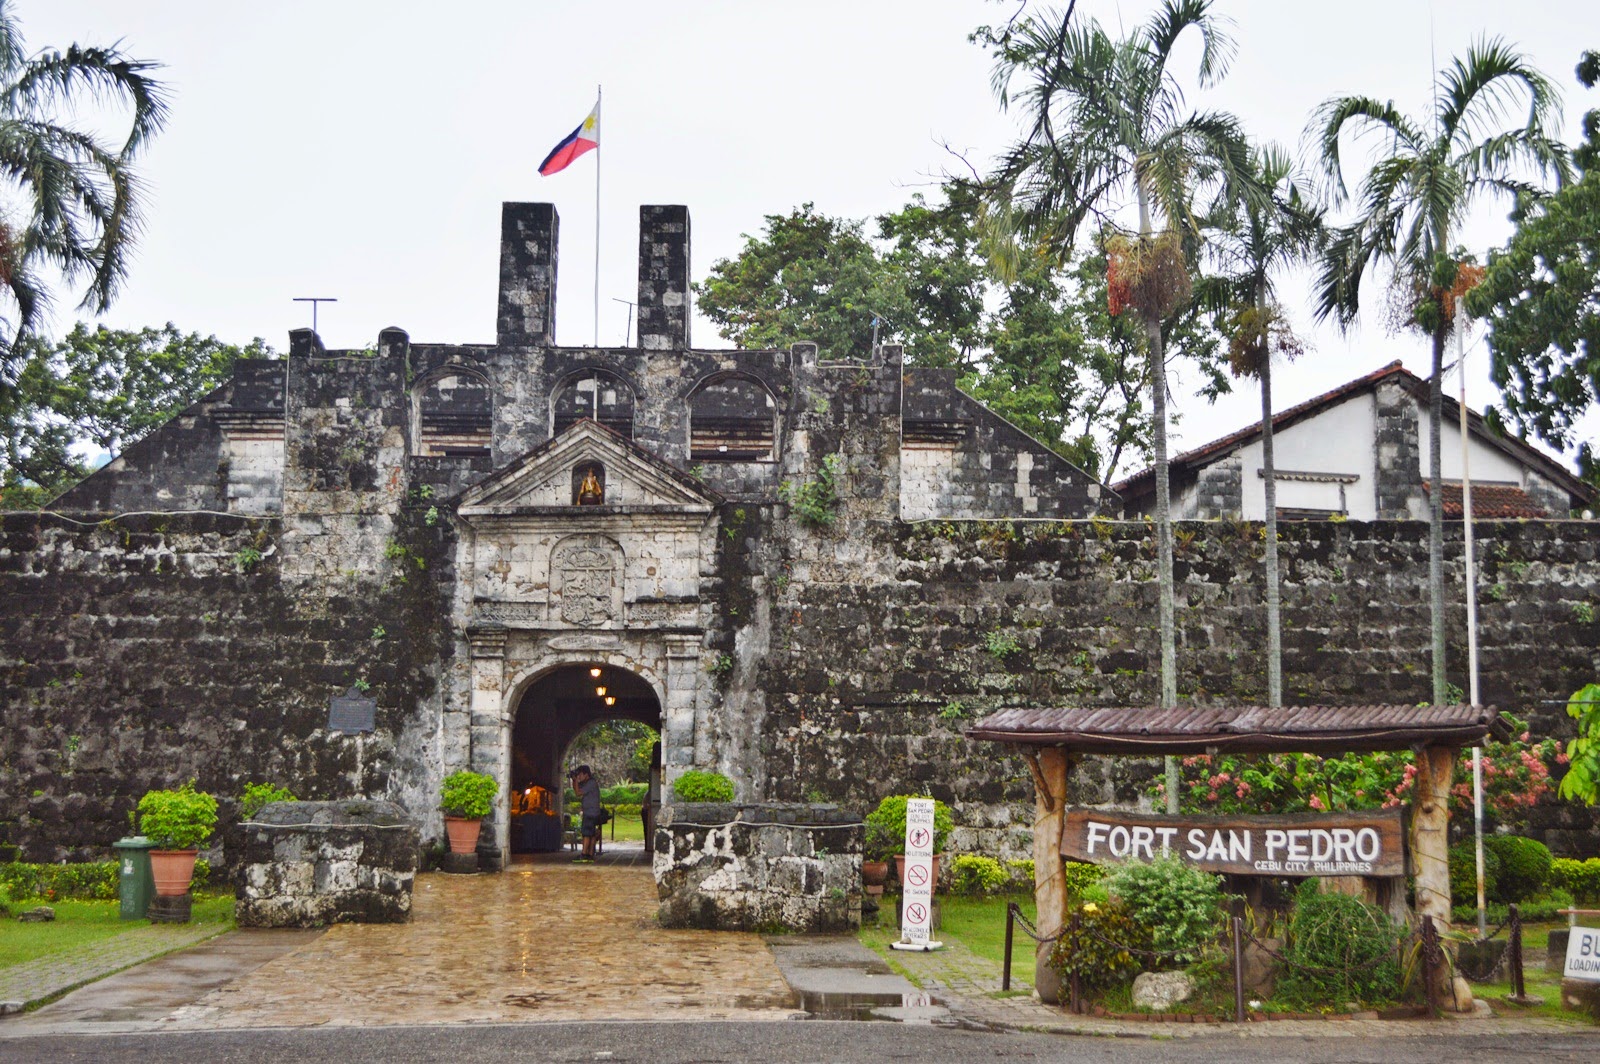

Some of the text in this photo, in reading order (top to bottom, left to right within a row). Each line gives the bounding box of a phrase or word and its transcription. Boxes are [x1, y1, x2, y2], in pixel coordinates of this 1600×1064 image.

[1087, 821, 1379, 861] FORT SAN PEDRO
[1254, 861, 1281, 871] CEBU
[1314, 861, 1371, 872] PHILIPPINES
